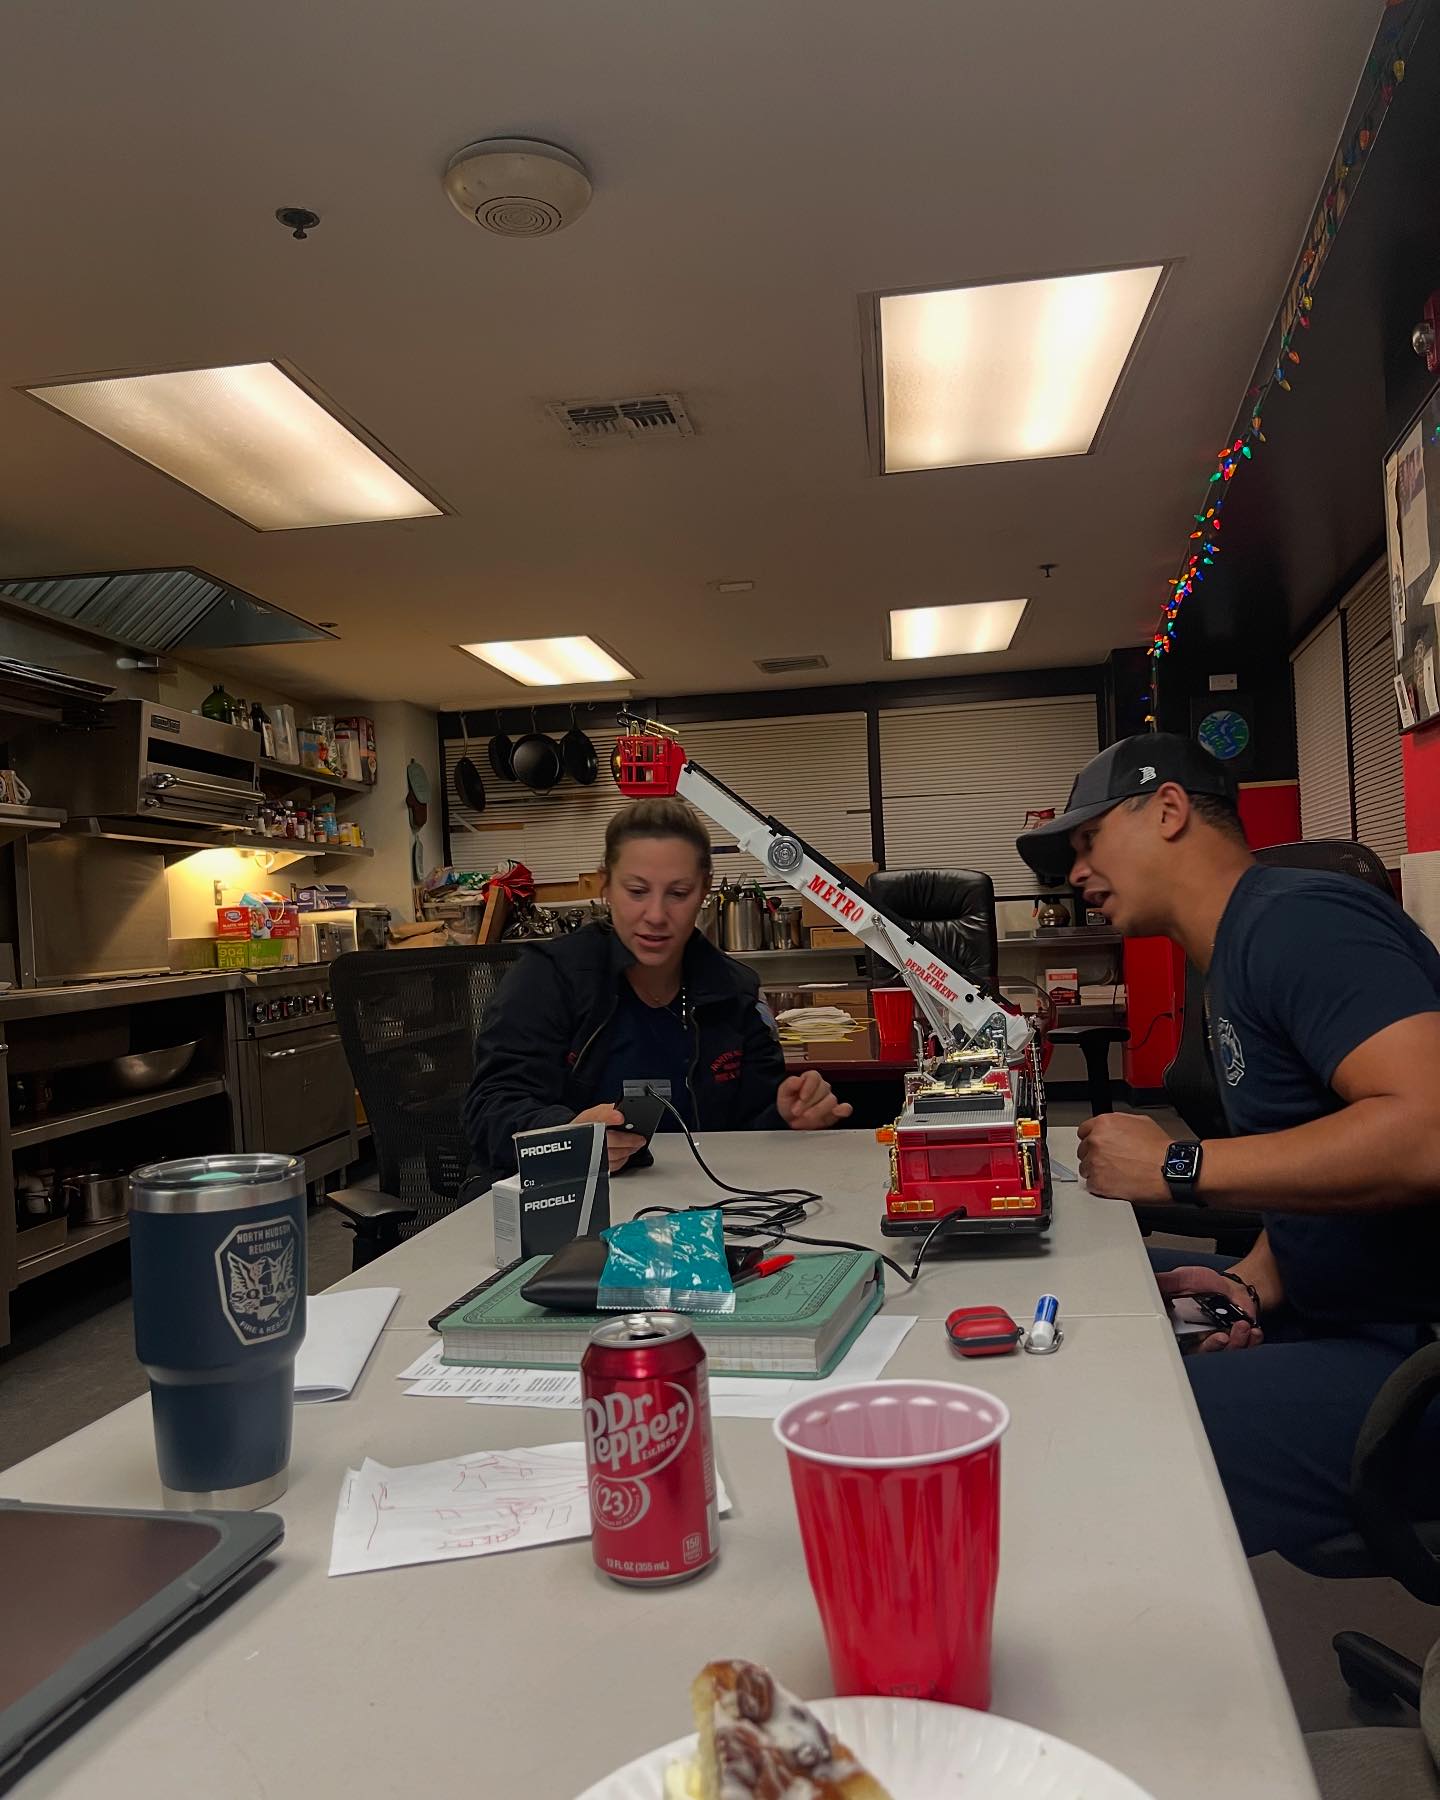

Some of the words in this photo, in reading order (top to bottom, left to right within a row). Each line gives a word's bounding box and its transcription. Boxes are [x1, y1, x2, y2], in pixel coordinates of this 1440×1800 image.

[807, 874, 864, 923] METRO
[219, 948, 245, 958] 904
[219, 957, 245, 968] FILM
[904, 958, 959, 1002] DEPARTMENT
[926, 961, 949, 982] FIRE
[520, 1141, 572, 1158] PROCELL
[524, 1194, 576, 1212] PROCELL
[237, 1230, 264, 1244] NORTH
[264, 1223, 291, 1240] HUDSON
[605, 1391, 653, 1433] Dr
[584, 1397, 686, 1472] Pepper
[600, 1486, 625, 1517] 23
[614, 1559, 622, 1570] FL
